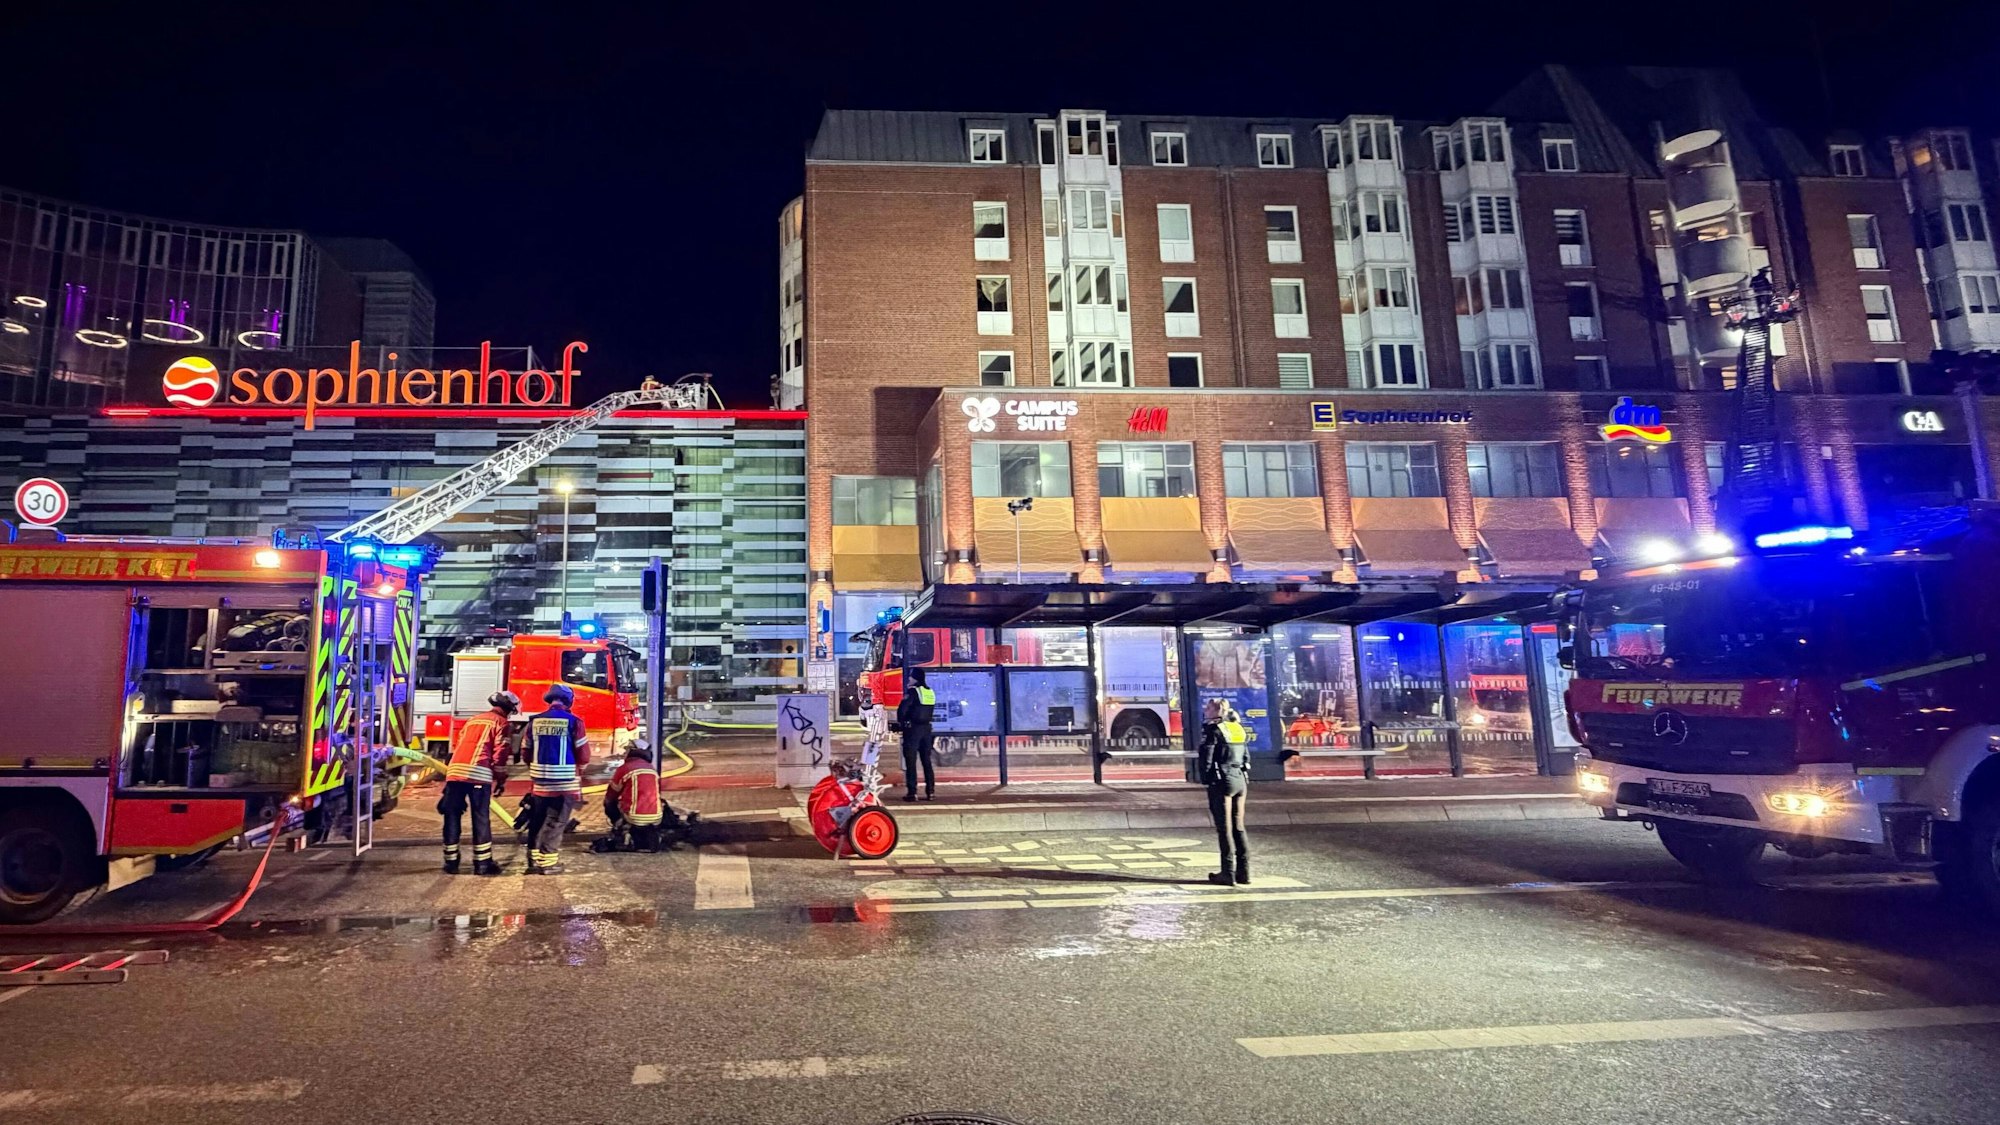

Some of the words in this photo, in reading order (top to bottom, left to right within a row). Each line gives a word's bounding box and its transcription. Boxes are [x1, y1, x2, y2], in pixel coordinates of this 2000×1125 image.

[229, 340, 589, 430] sophienhof
[1004, 400, 1079, 415] CAMPUS
[1341, 408, 1474, 424] Sophienhof
[1611, 396, 1662, 427] dm
[1017, 416, 1068, 431] SUITE
[1127, 406, 1169, 434] H&M
[1903, 411, 1945, 431] C&A
[27, 491, 57, 513] 30
[127, 558, 191, 576] KIEL
[1601, 683, 1744, 706] FEUERWEHR
